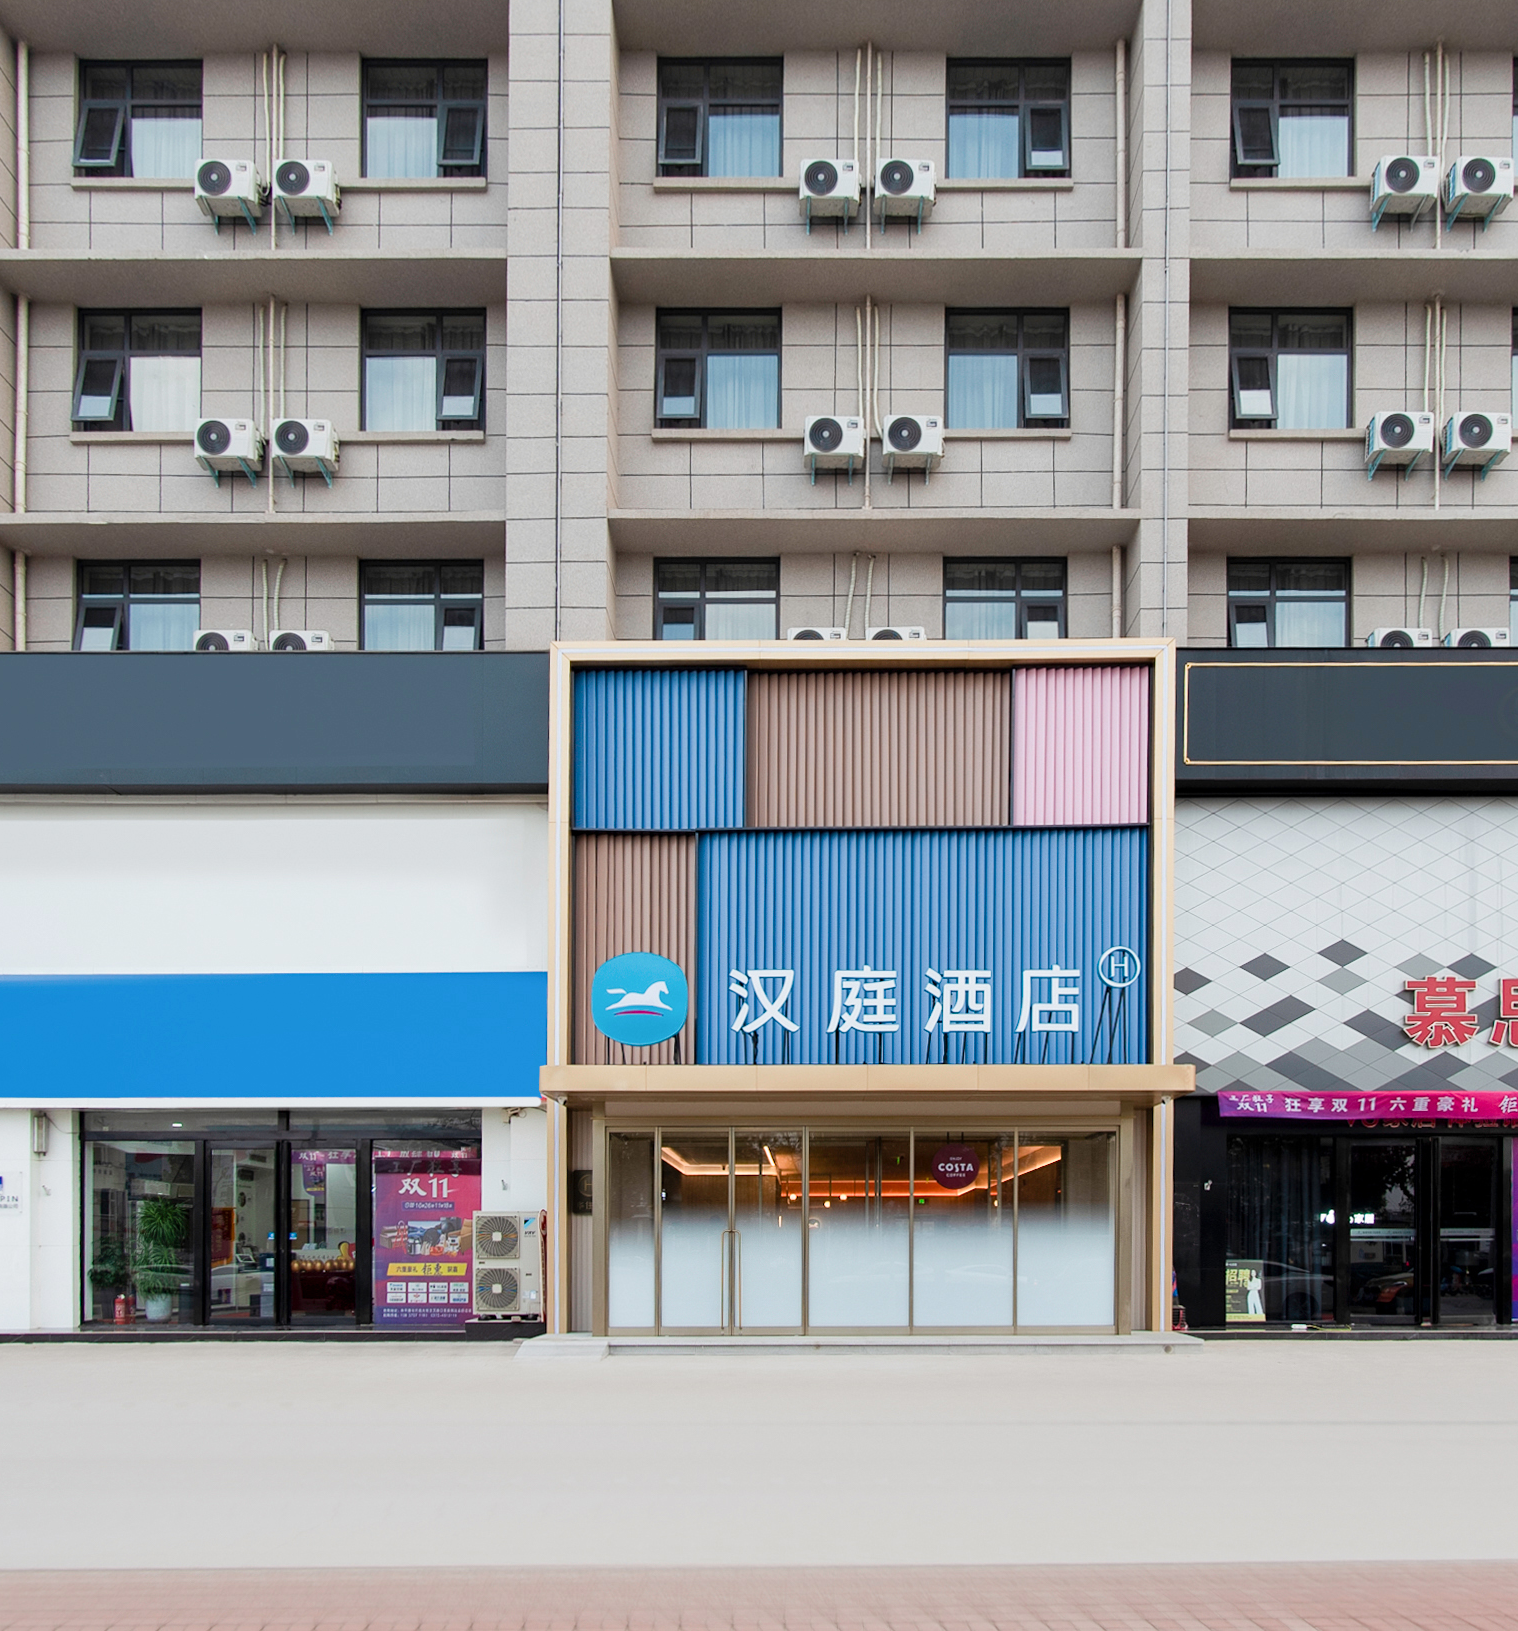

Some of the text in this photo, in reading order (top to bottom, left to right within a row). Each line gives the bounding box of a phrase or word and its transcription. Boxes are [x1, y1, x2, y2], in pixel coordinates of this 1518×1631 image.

[728, 964, 1082, 1034] 汉庭酒店
[1236, 1102, 1268, 1113] 双11
[1284, 1097, 1376, 1113] 狂享双11
[1389, 1096, 1479, 1113] 六重豪礼
[938, 1163, 974, 1172] COSTA
[398, 1177, 448, 1198] 双11
